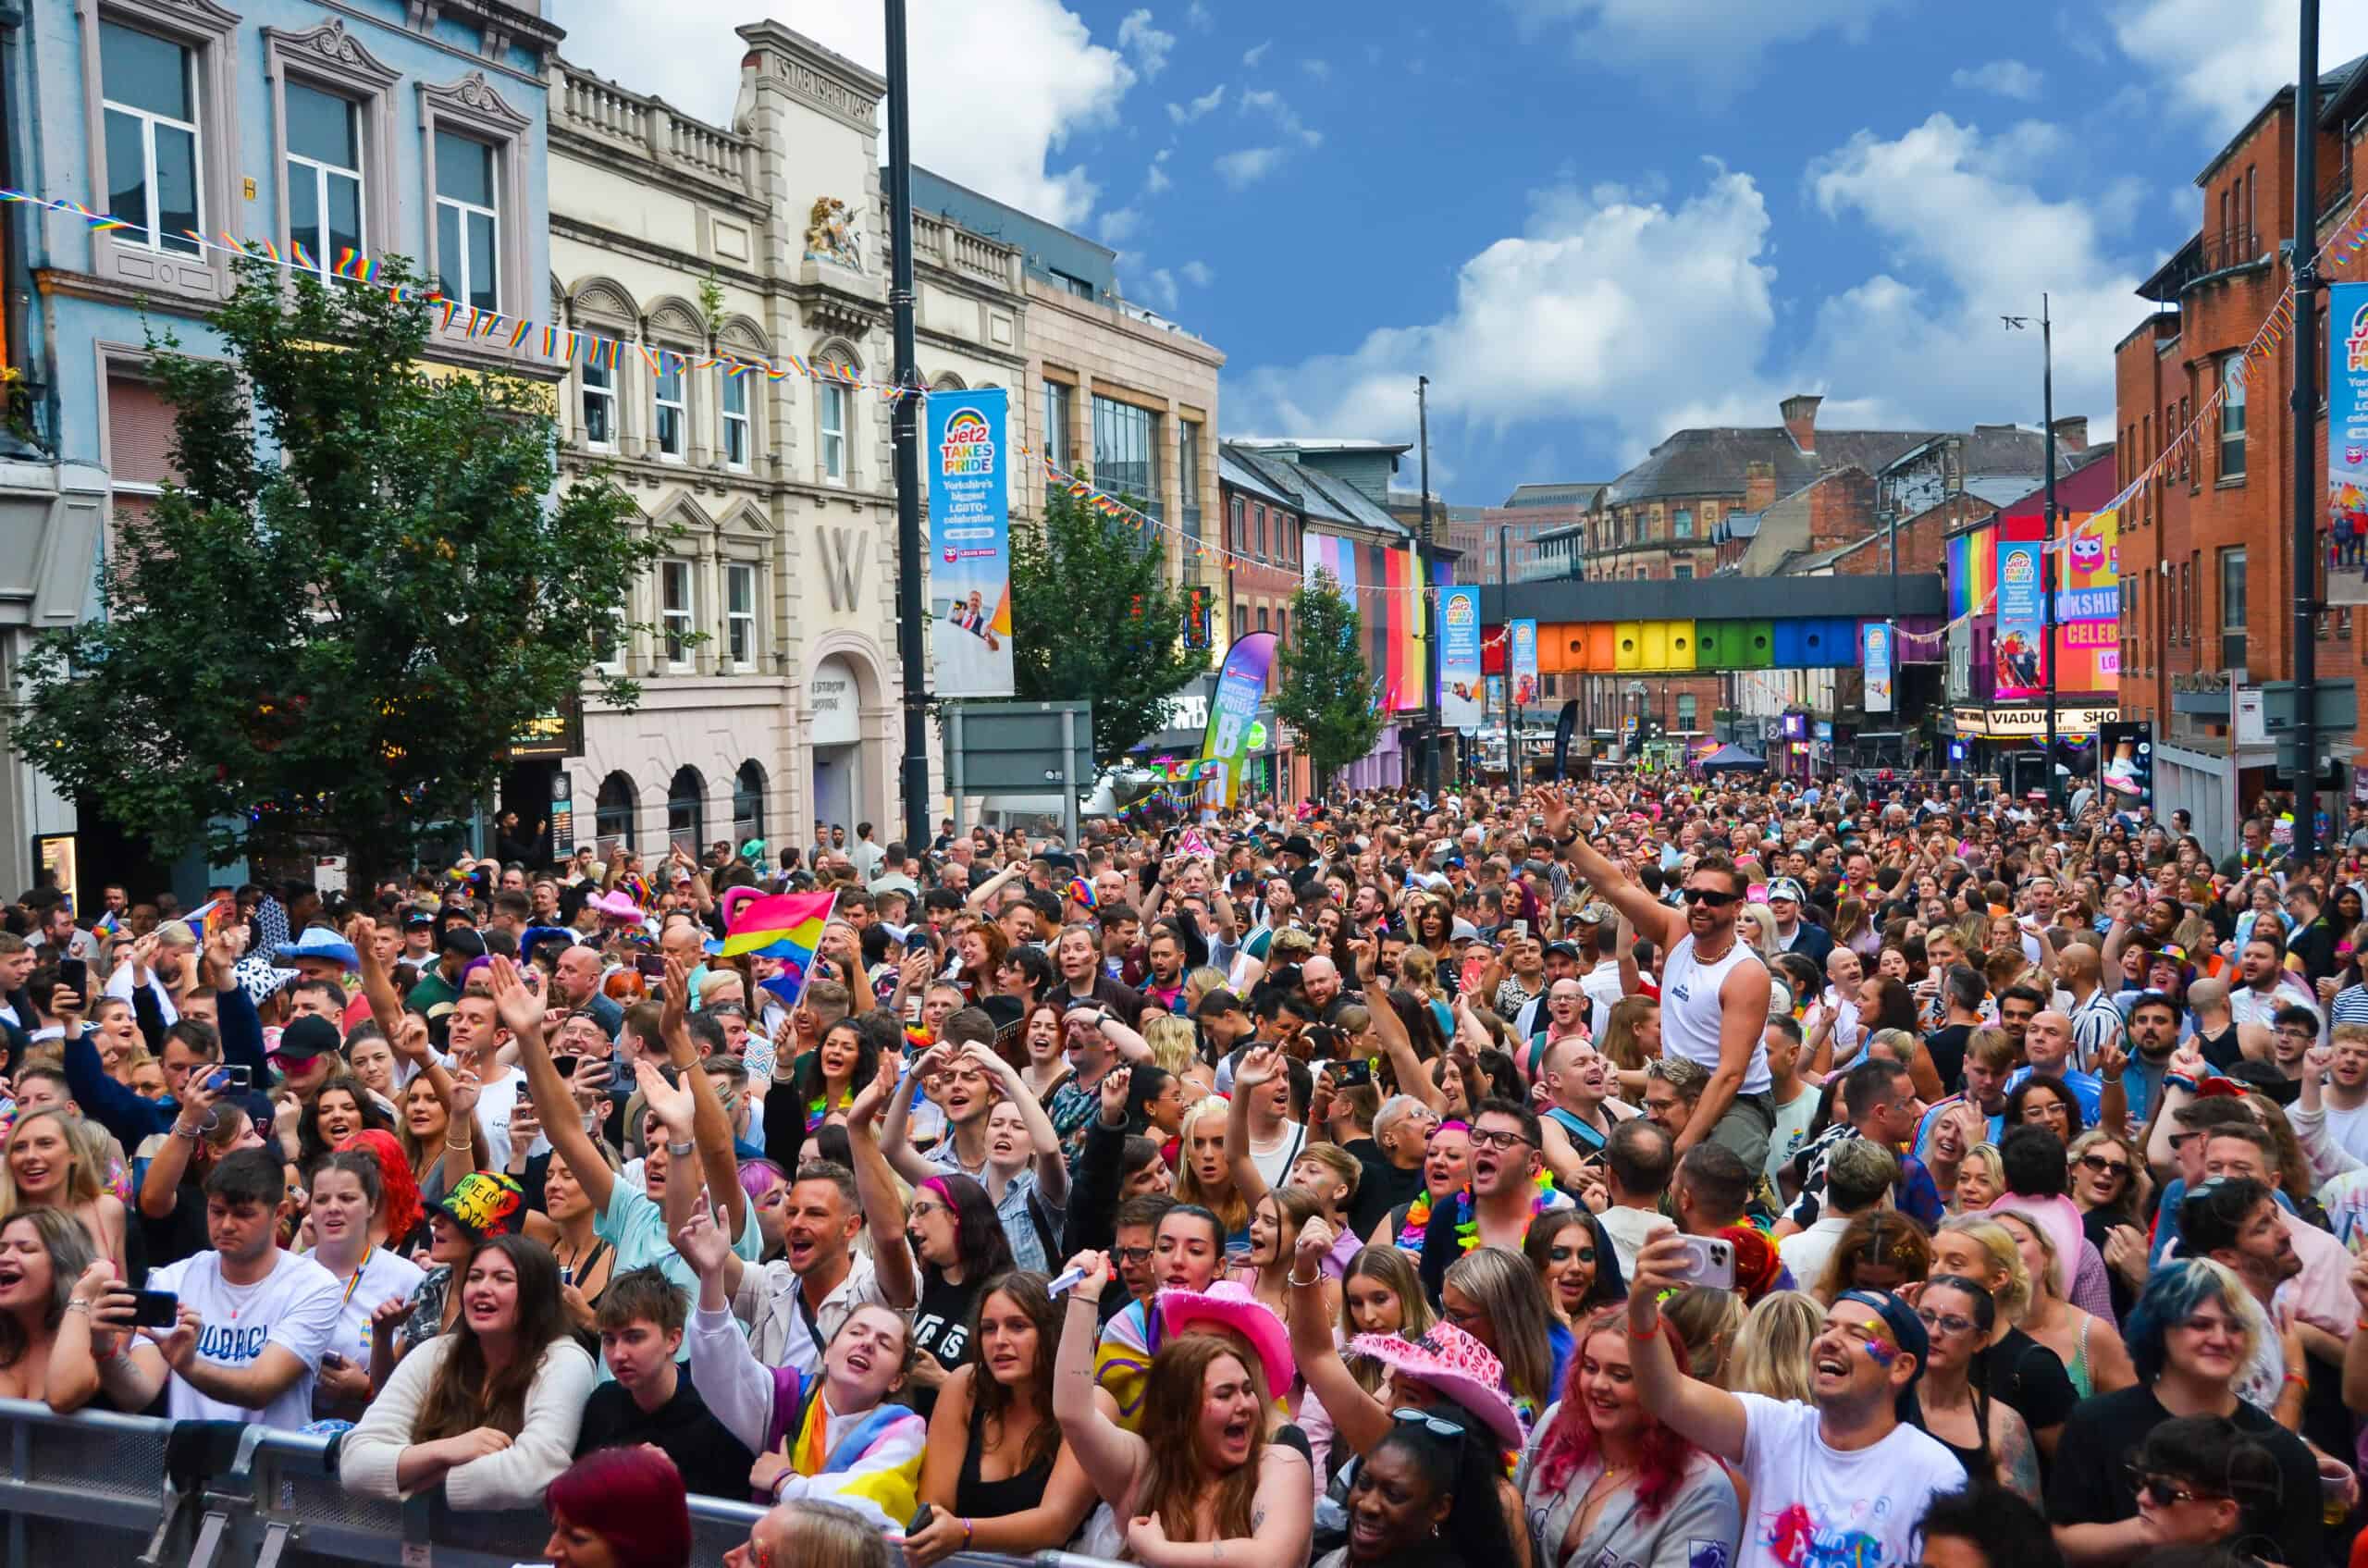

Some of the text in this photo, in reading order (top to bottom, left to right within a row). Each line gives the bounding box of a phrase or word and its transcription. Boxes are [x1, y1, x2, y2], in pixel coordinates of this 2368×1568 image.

[946, 426, 988, 444] Jet2
[942, 444, 993, 460] TAKES
[944, 458, 991, 475] PRIDE
[949, 502, 988, 513] LGBTQ+
[815, 524, 869, 613] W
[462, 1178, 511, 1210] ONE LOVE
